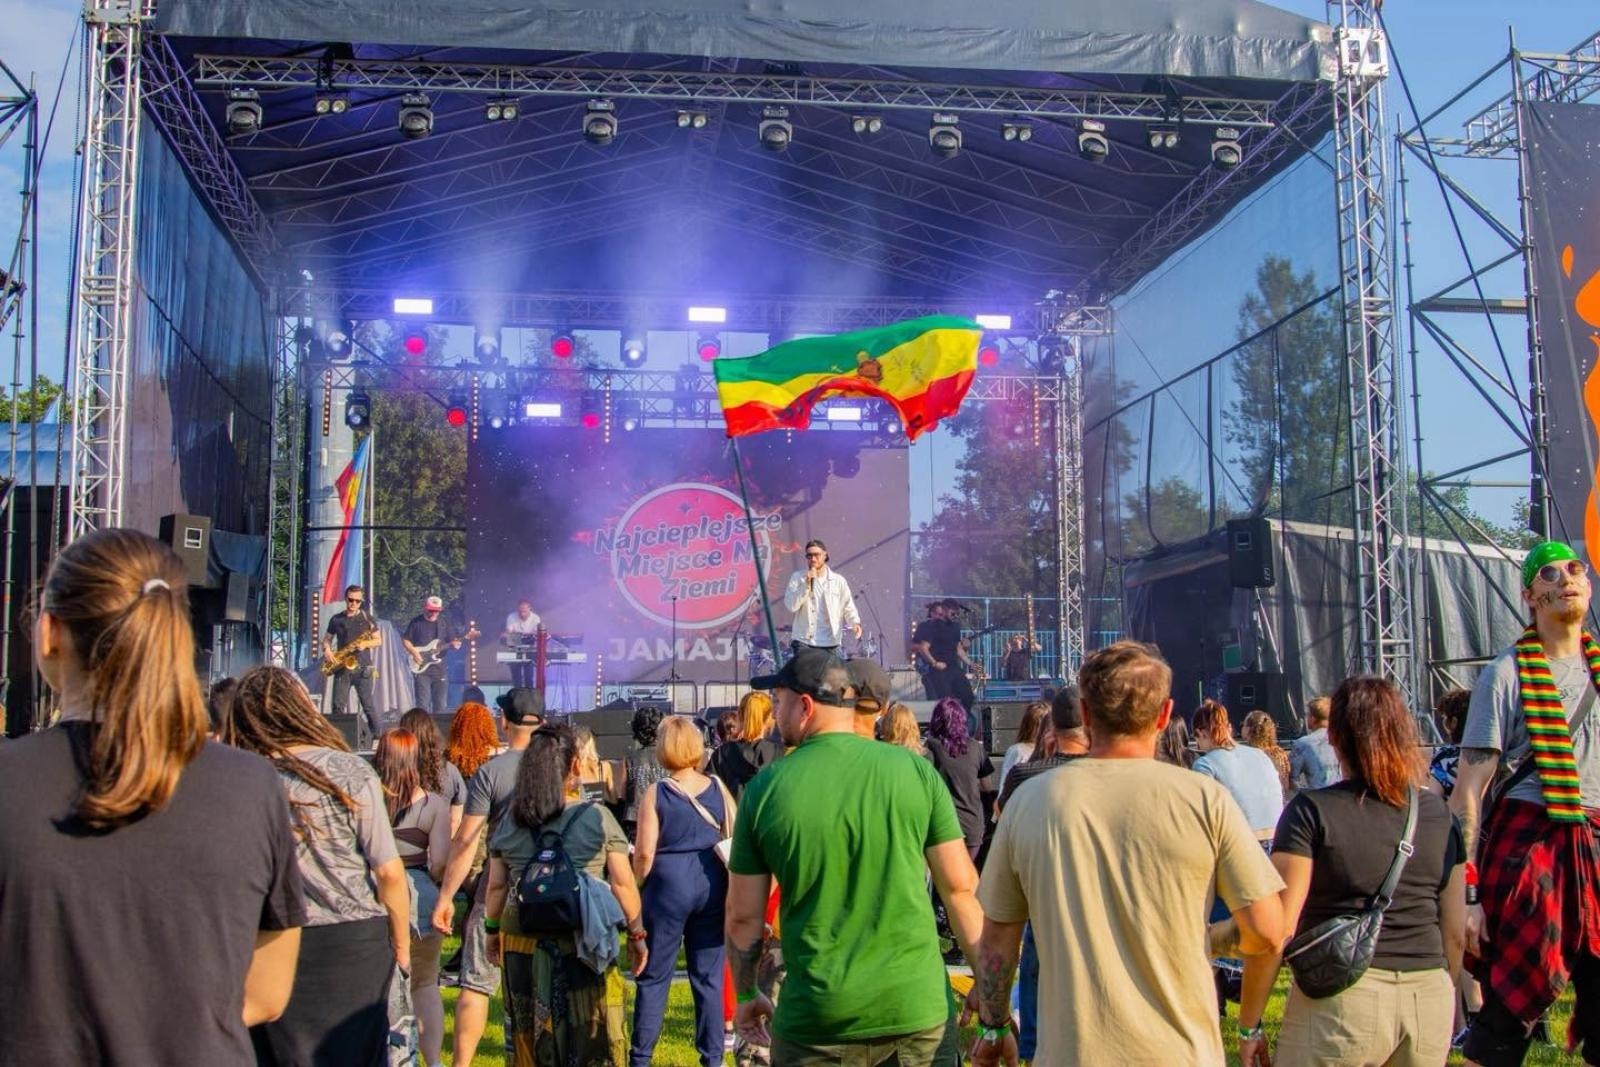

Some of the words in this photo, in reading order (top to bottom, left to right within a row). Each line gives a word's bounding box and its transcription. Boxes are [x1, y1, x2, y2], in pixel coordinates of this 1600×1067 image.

[594, 513, 782, 554] Najcieplejsze
[616, 549, 723, 579] Miejsce
[733, 539, 769, 564] Na
[659, 571, 738, 602] Ziemi
[608, 638, 754, 661] JAMAJK
